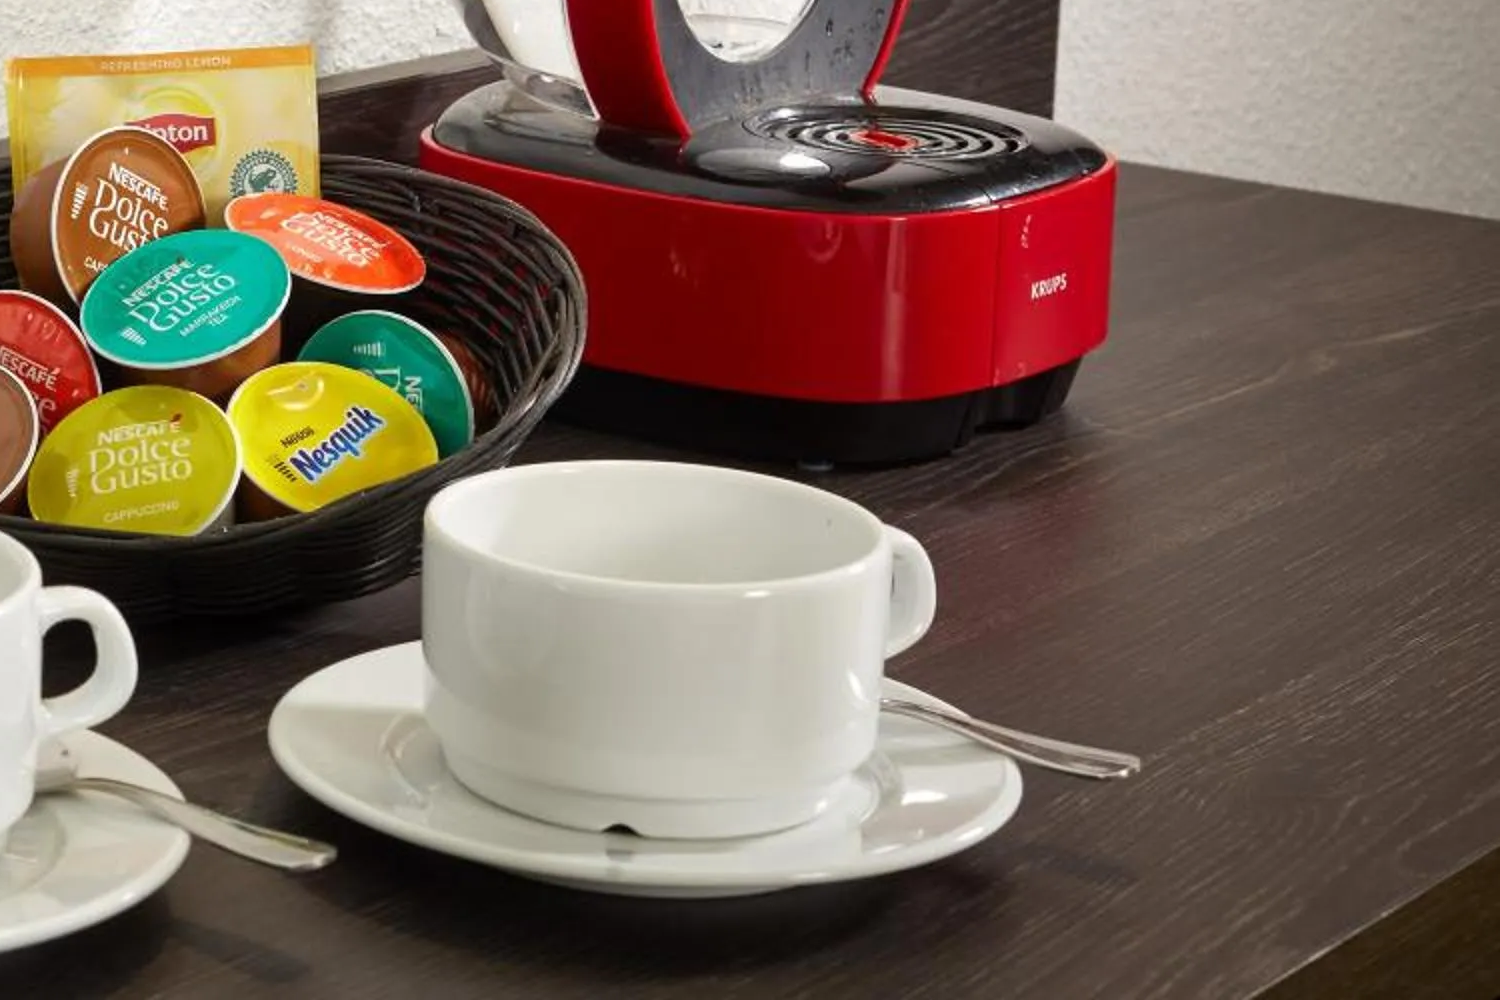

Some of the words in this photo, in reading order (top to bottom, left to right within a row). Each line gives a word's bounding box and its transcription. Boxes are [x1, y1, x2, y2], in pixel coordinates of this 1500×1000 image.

[89, 208, 151, 252] Gust
[95, 178, 169, 240] Dolce
[128, 264, 222, 323] Dolce
[149, 274, 236, 332] Gusto
[1031, 272, 1067, 300] KRUPS
[89, 437, 191, 474] Dolce
[289, 406, 384, 482] Nesquik
[90, 458, 192, 494] Gusto
[103, 500, 180, 522] CAPPUCCINO
